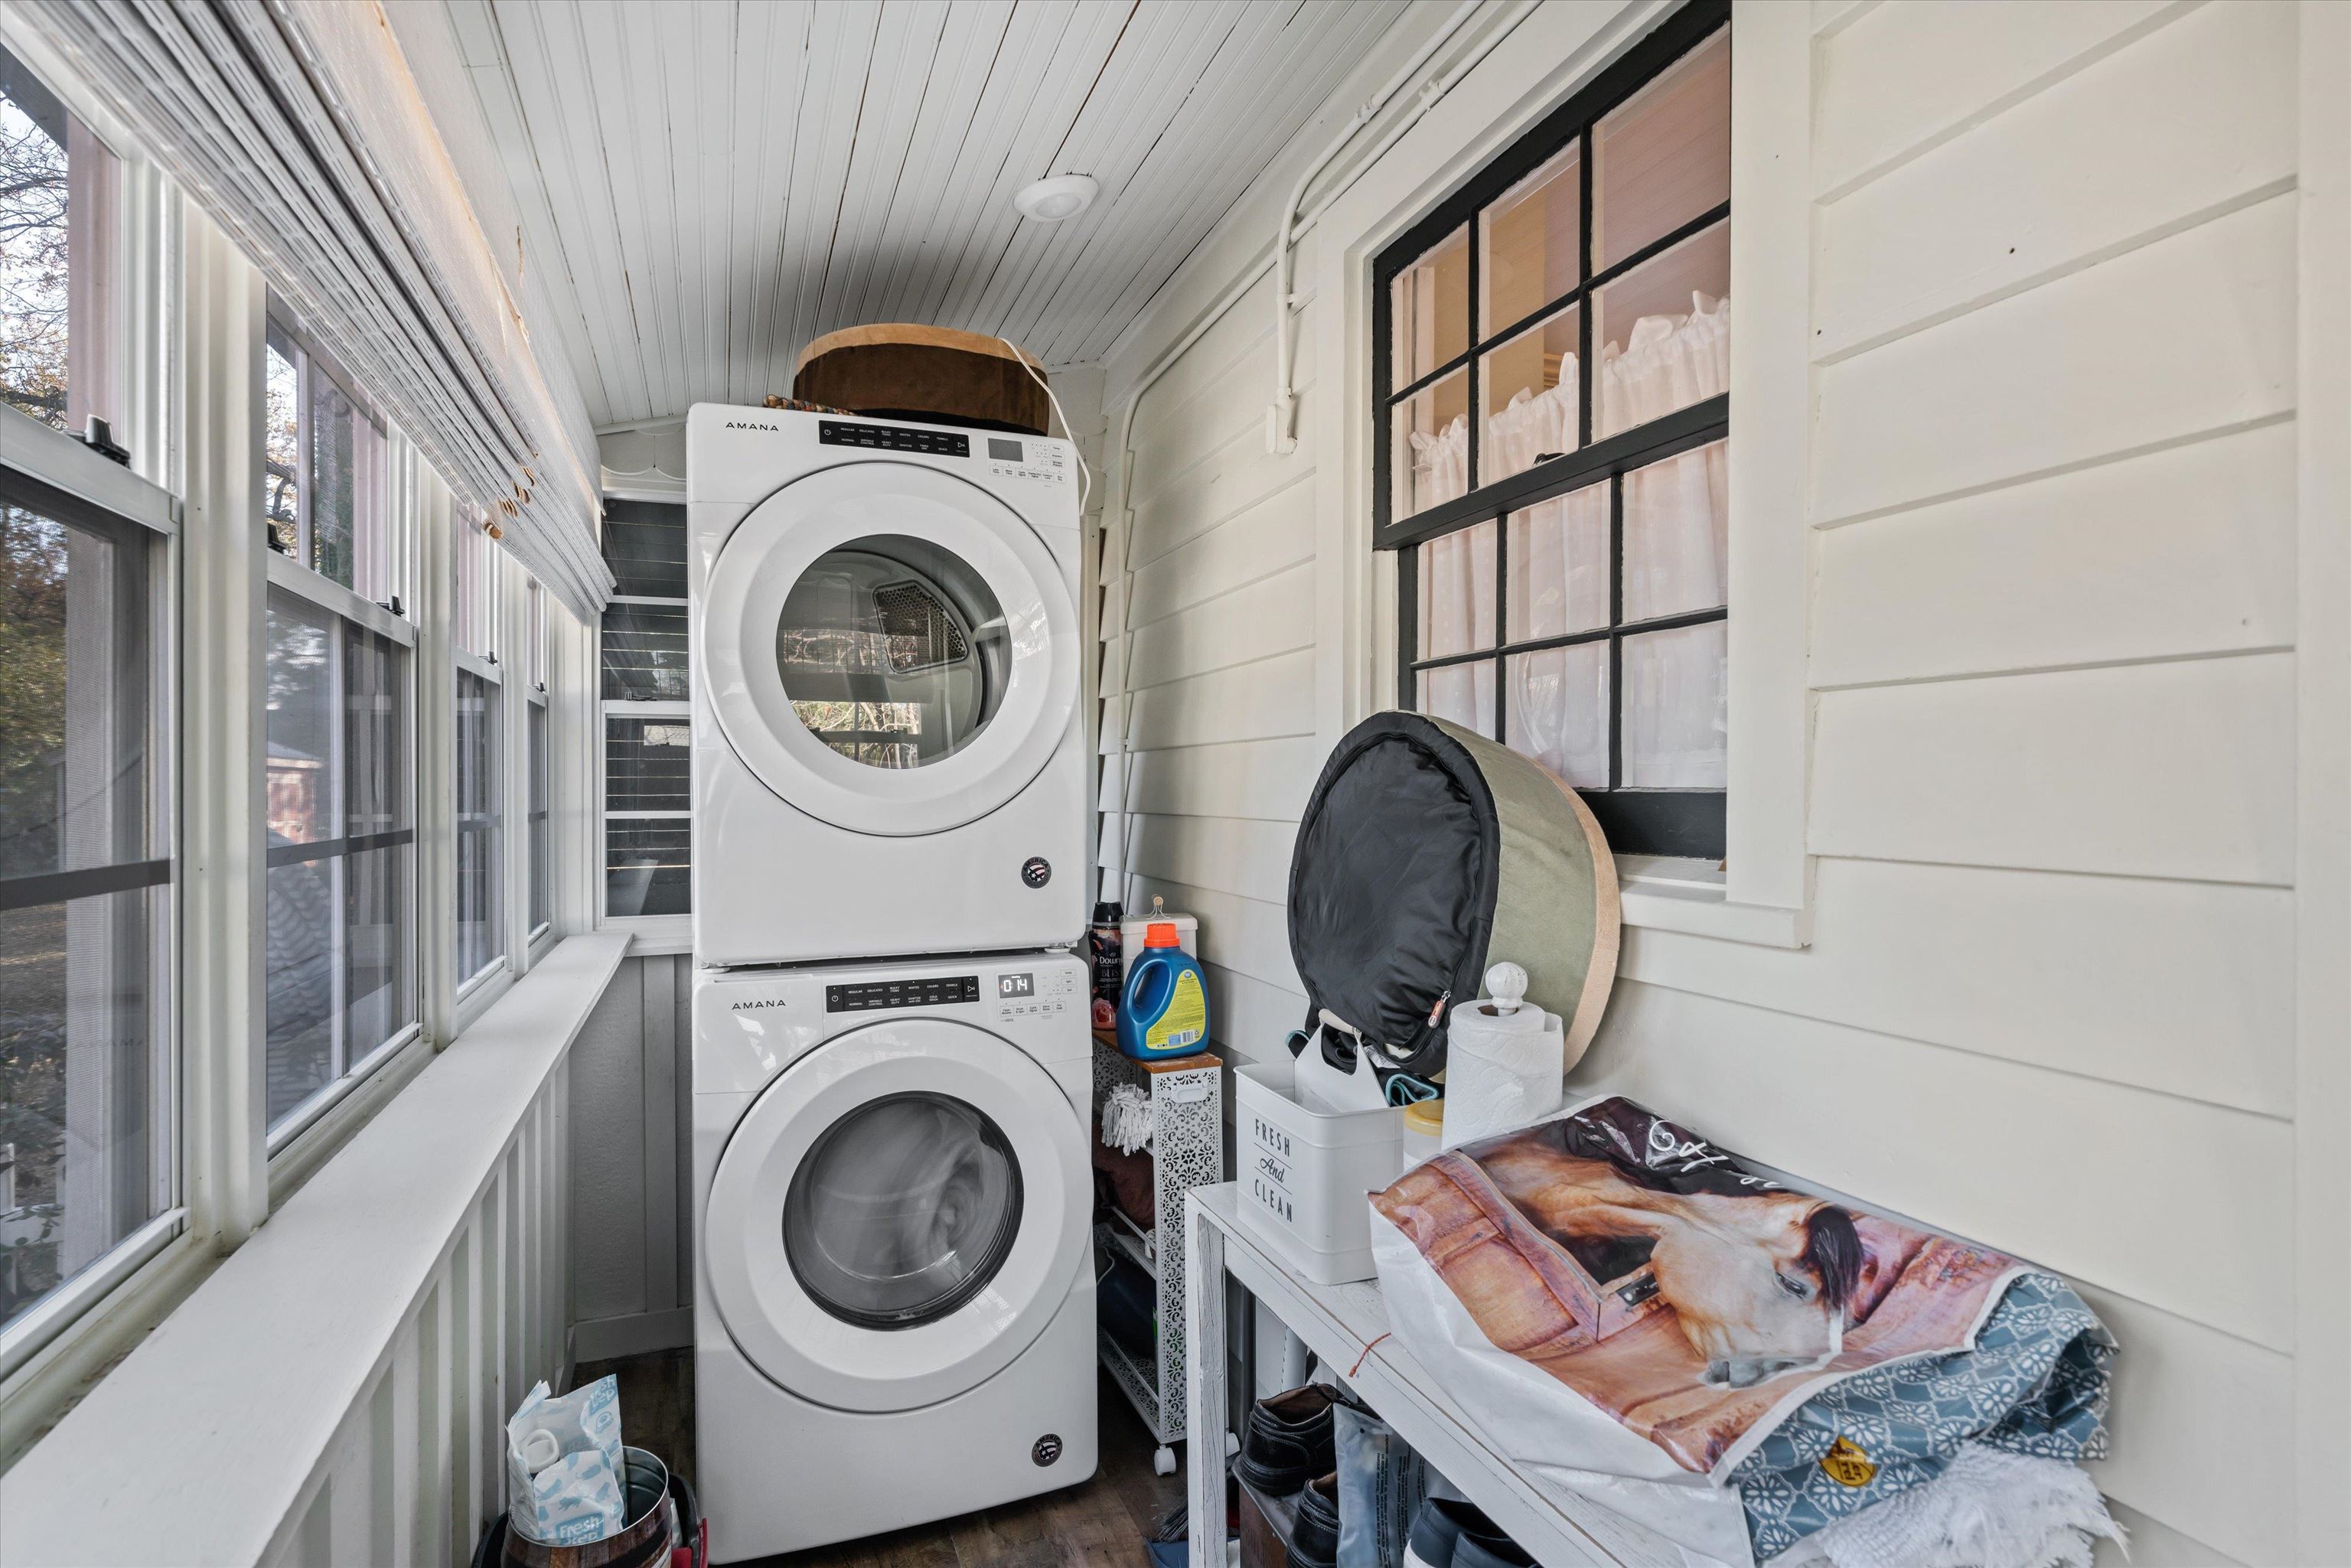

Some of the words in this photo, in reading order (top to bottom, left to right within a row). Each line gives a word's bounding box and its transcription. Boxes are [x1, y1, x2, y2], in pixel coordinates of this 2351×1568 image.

[726, 422, 779, 432] AMANA
[732, 999, 786, 1010] AMANA
[1255, 1118, 1290, 1157] FRESH
[1260, 1157, 1286, 1183] And
[1254, 1178, 1293, 1223] CLEAN
[560, 1517, 599, 1538] Fresh
